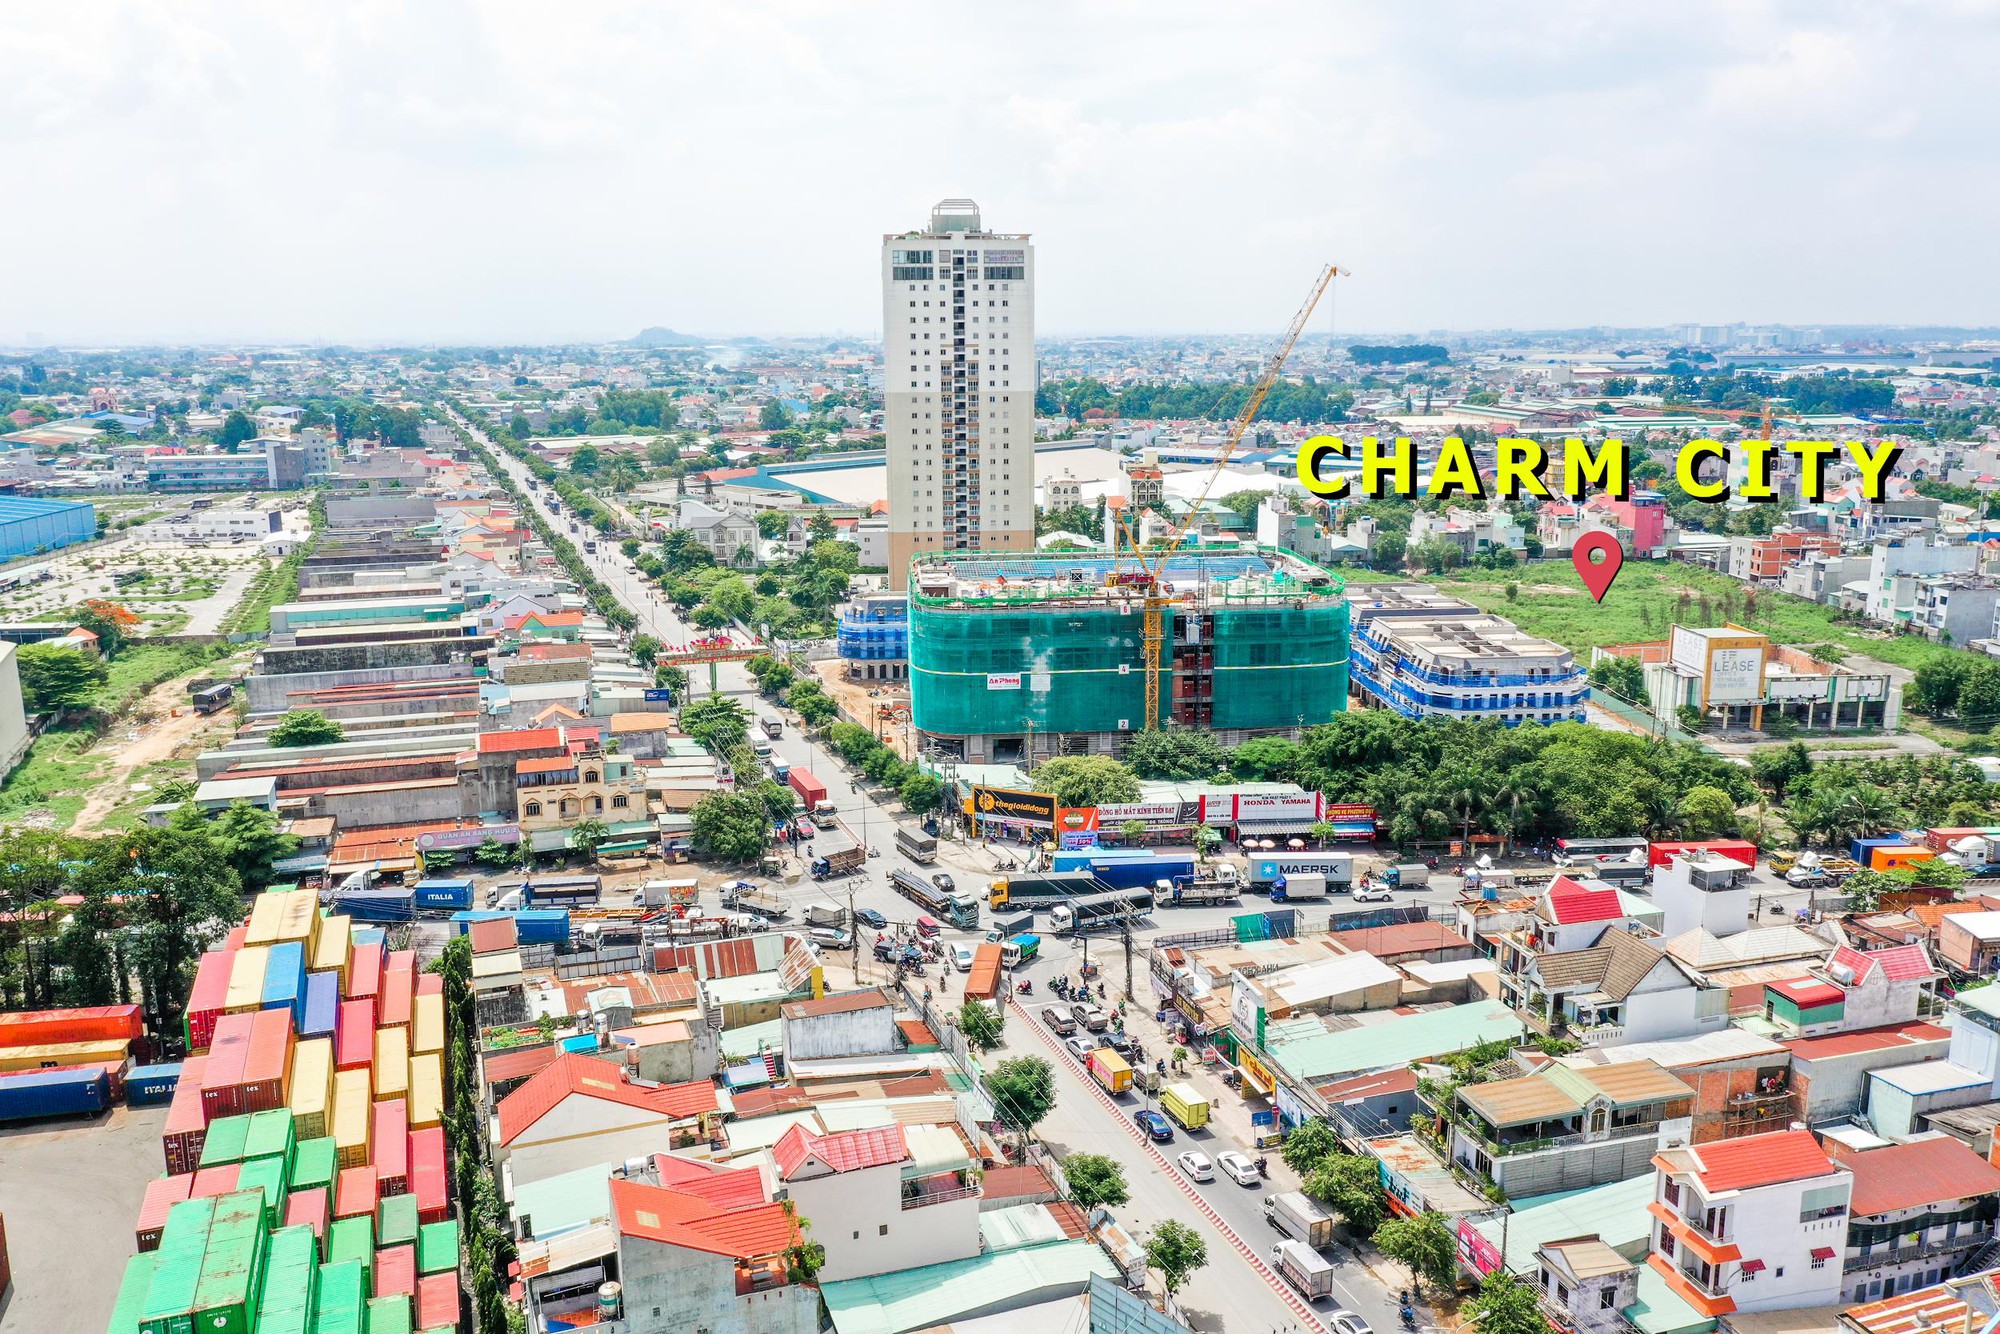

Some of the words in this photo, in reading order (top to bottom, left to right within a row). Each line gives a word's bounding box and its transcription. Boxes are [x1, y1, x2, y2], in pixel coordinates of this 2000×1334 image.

[1123, 605, 1128, 614] 6
[1714, 660, 1754, 672] LEASE
[1121, 720, 1126, 728] 2
[995, 800, 1050, 815] thegioididong
[1280, 864, 1338, 874] MAERSK
[141, 1233, 157, 1241] tex
